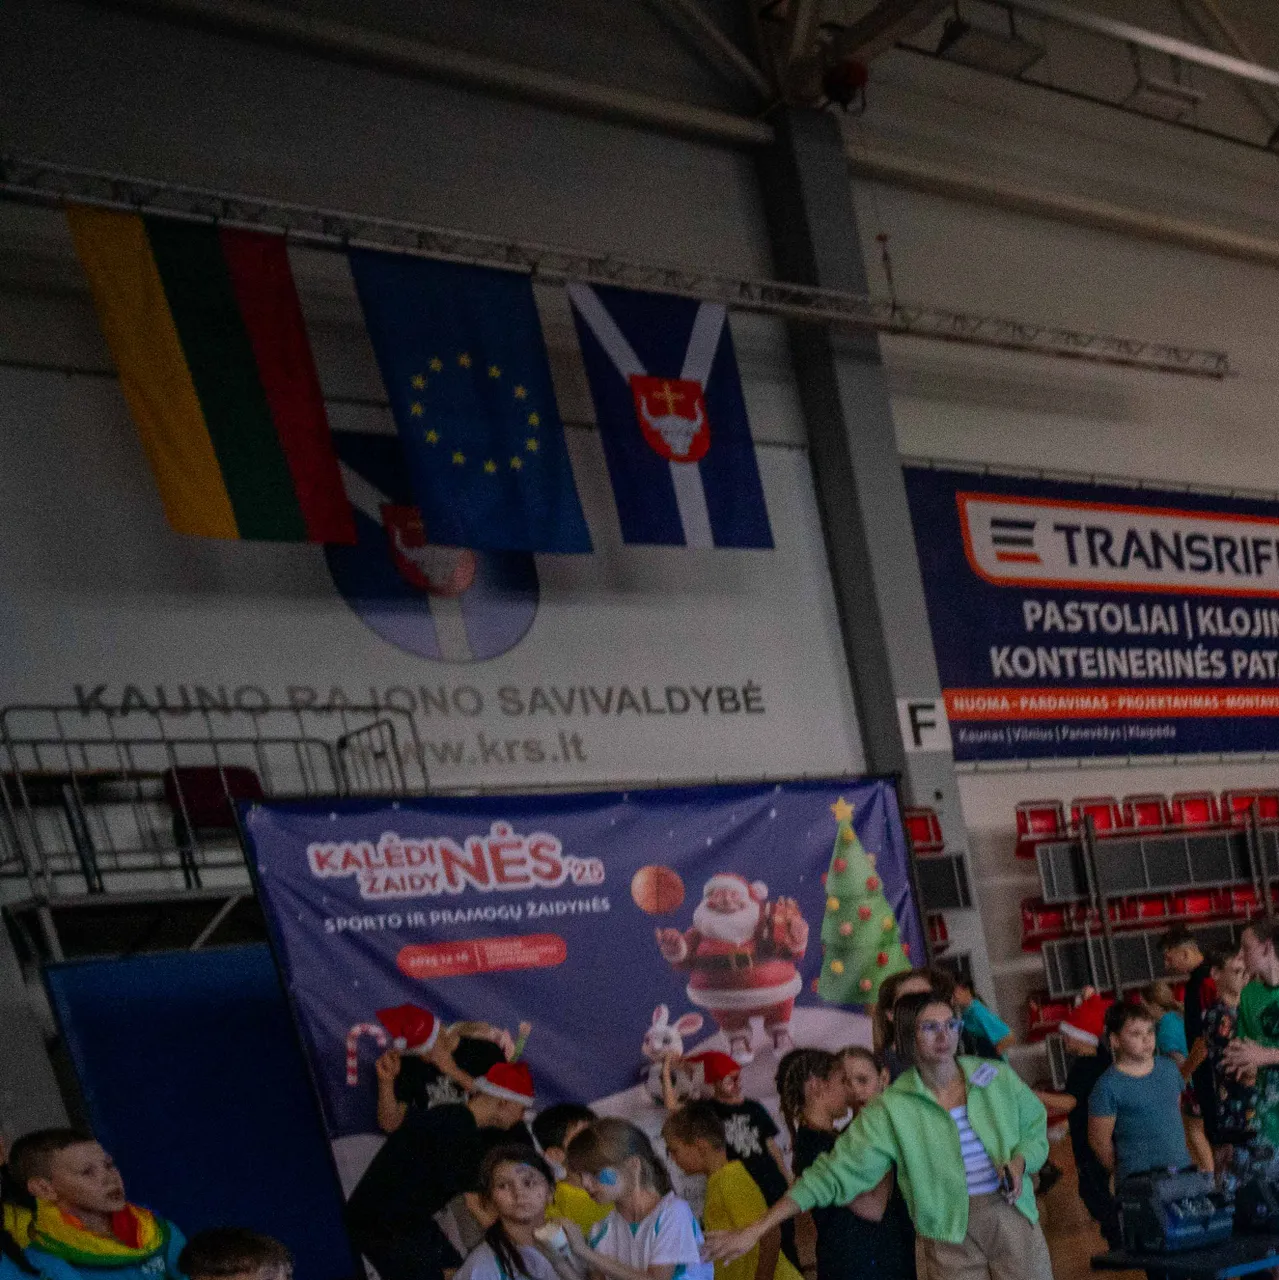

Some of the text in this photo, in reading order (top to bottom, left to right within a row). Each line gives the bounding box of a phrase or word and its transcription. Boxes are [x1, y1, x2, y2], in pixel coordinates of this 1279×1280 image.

[1022, 600, 1179, 636] PASTOLIAI
[989, 643, 1227, 680] KONTEINERINĖS
[74, 683, 269, 717] KAUNO
[497, 680, 766, 717] SAVIVALDYBĖ
[953, 695, 1011, 712] NUOMA
[1019, 695, 1110, 712] PARDAVIMAS
[1116, 695, 1220, 711] PROJEKTAVIMAS
[907, 704, 937, 747] F
[325, 896, 611, 934] SPORTO IR PRAMOGŲ ŽAIDYNĖS
